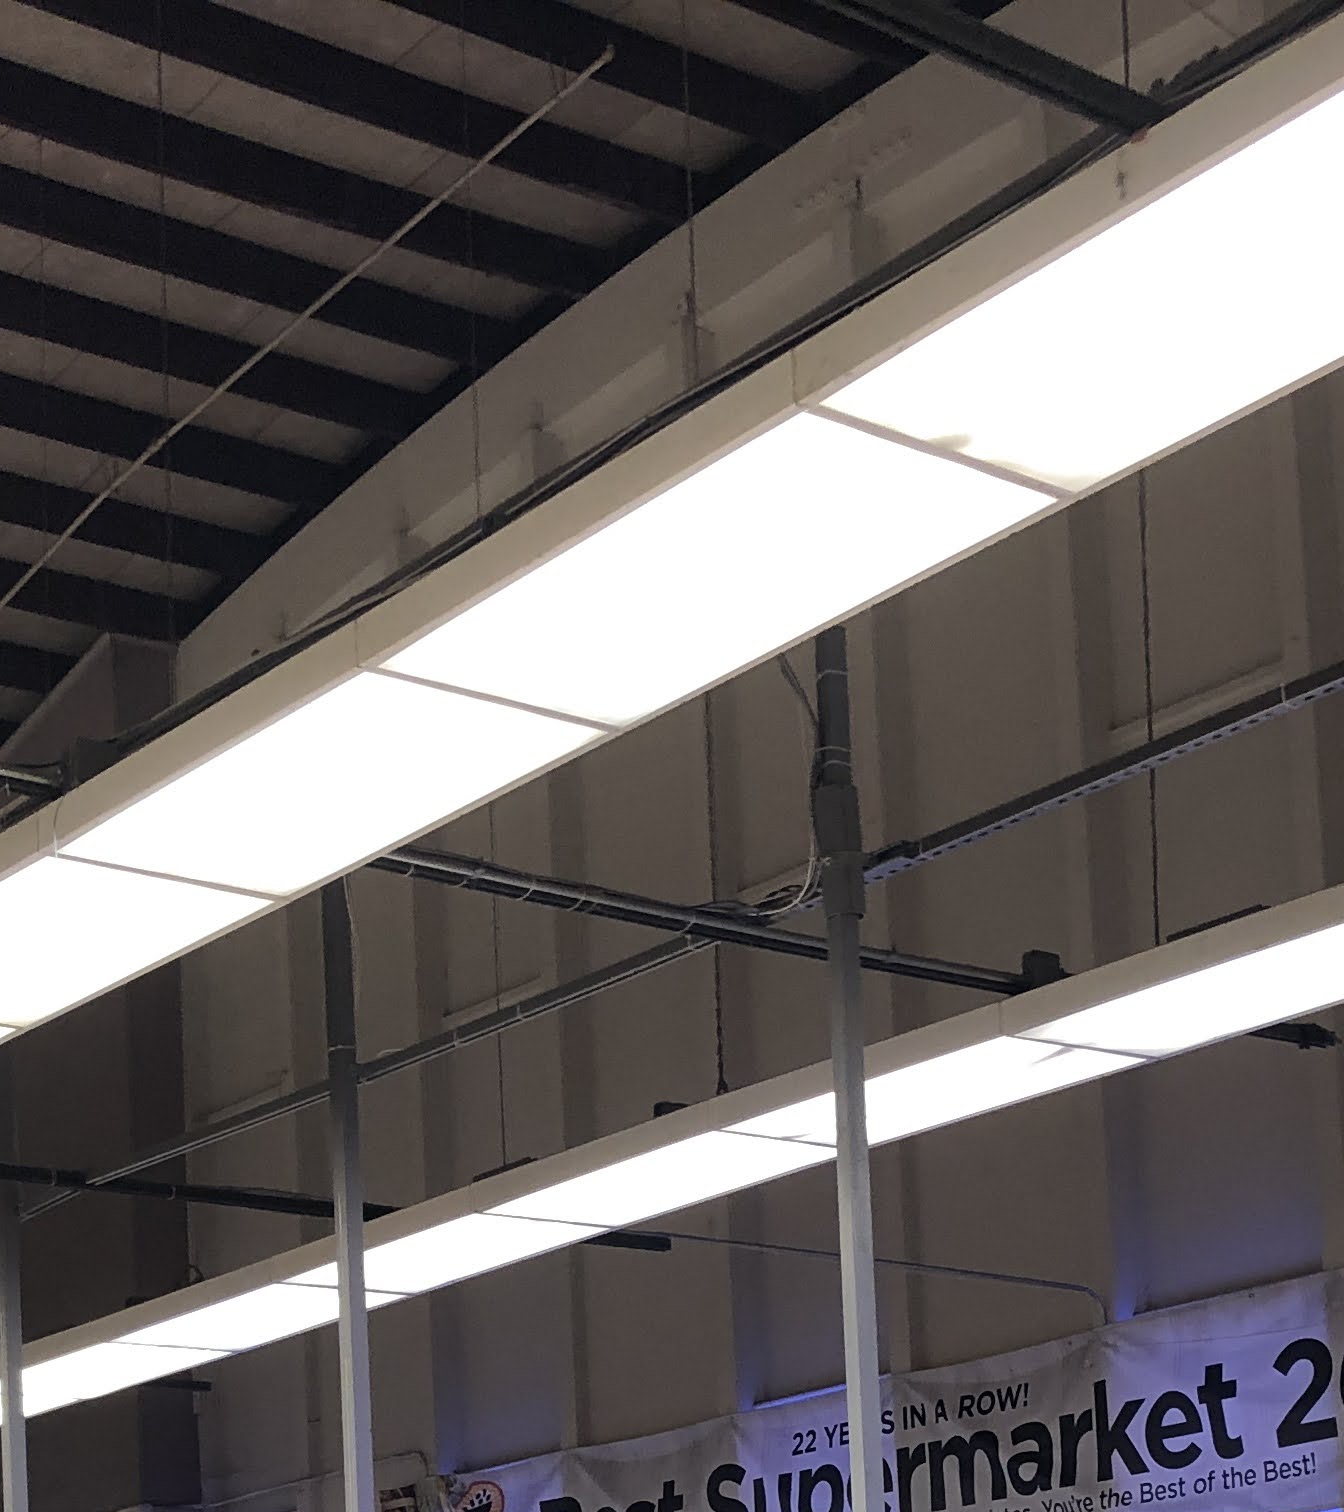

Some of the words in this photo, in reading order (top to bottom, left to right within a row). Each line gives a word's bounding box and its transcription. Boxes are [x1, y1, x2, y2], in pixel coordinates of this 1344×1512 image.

[791, 1429, 816, 1456] 22
[823, 1410, 895, 1449] YES
[902, 1402, 926, 1430] IN
[935, 1399, 948, 1424] A
[957, 1382, 1030, 1419] ROW!
[1099, 1486, 1132, 1511] the
[1139, 1477, 1185, 1503] Best
[1192, 1470, 1215, 1494] of
[1222, 1463, 1257, 1489] the
[1263, 1451, 1317, 1482] Best!
